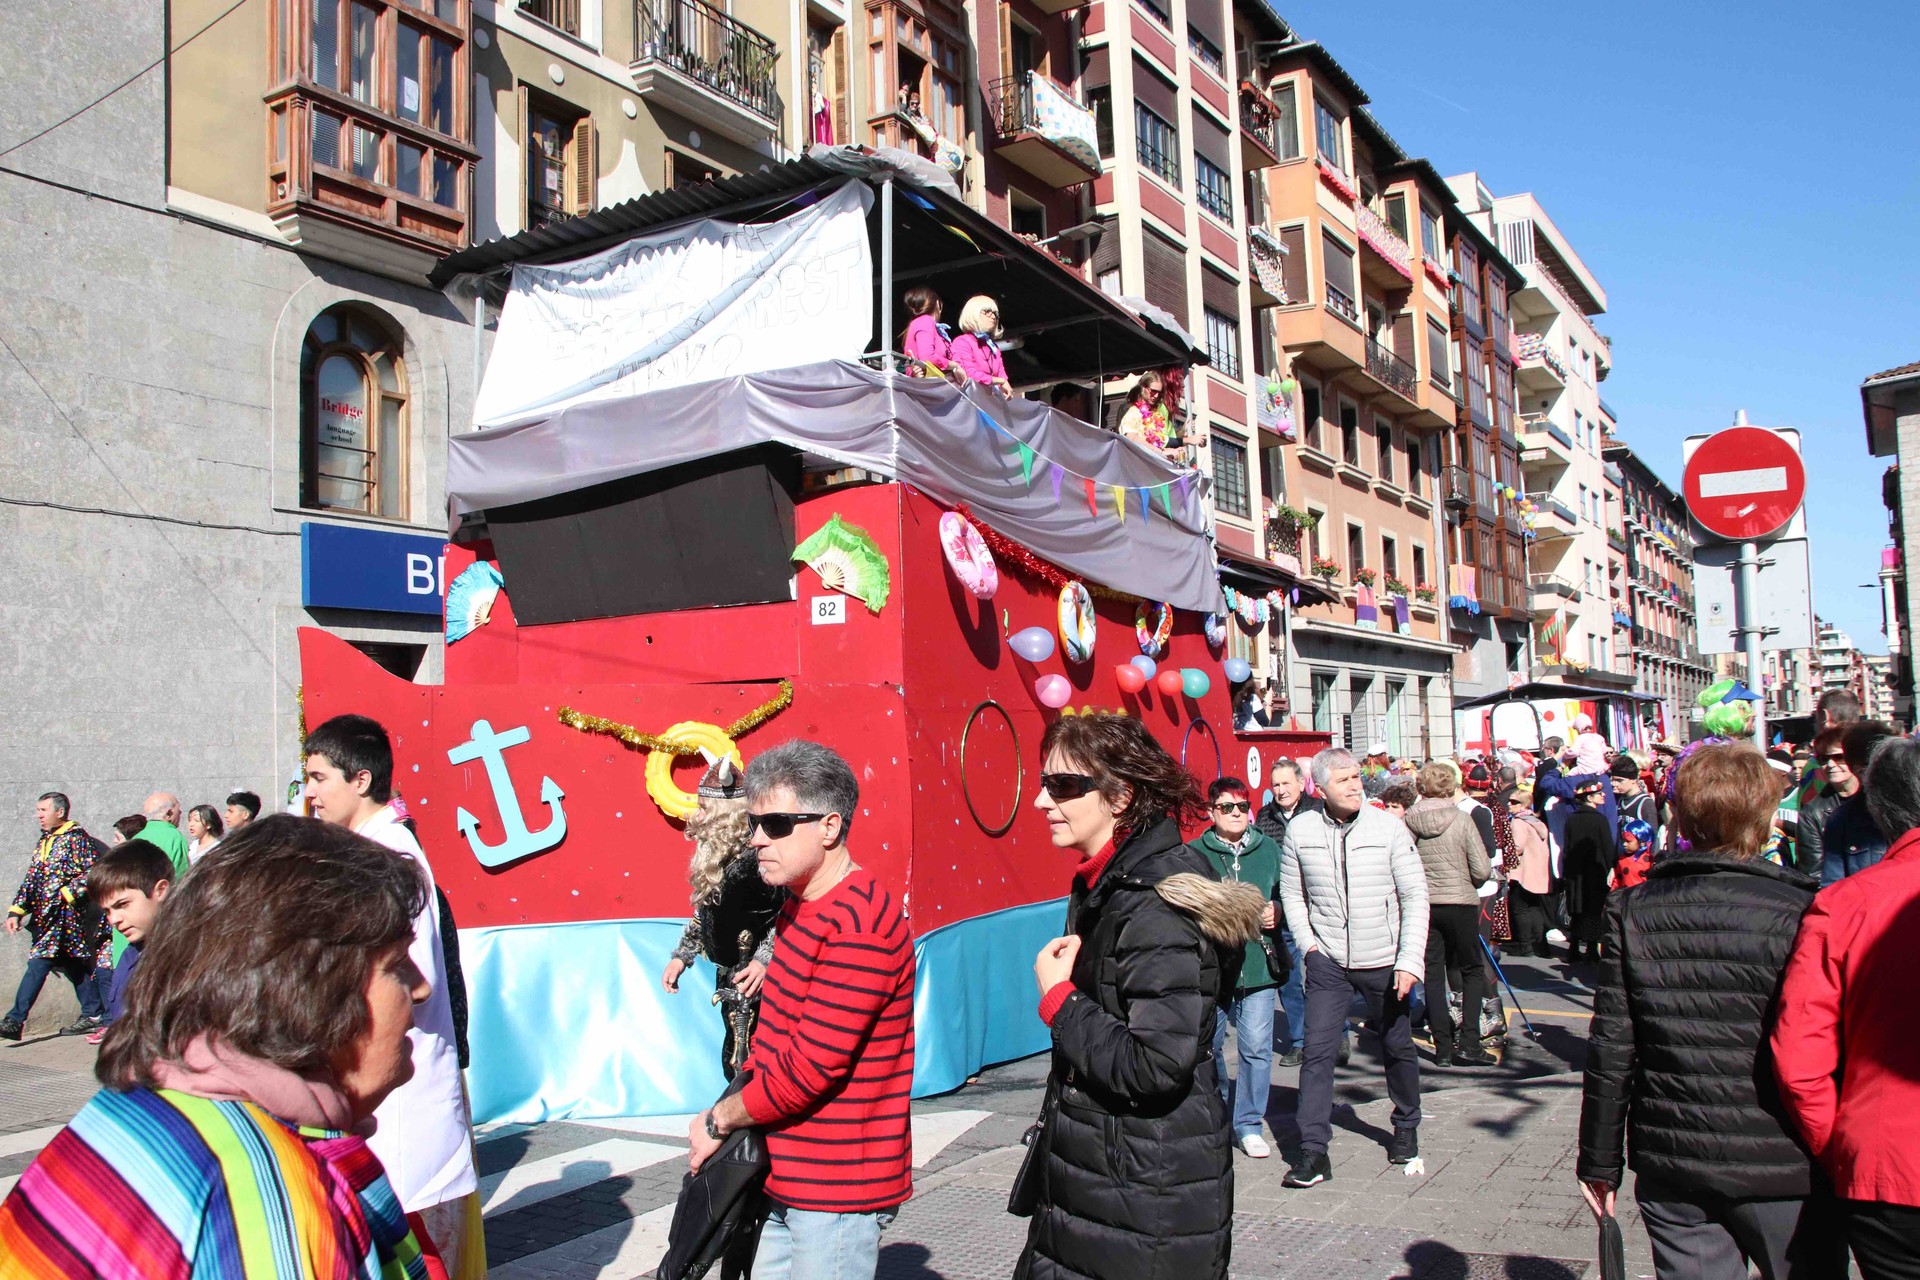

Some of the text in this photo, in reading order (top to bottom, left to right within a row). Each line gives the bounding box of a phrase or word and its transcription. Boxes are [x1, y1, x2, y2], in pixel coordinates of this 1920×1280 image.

[321, 398, 363, 419] Bridge
[326, 424, 357, 436] language
[331, 434, 353, 444] school
[407, 553, 446, 596] B
[818, 601, 836, 617] 82
